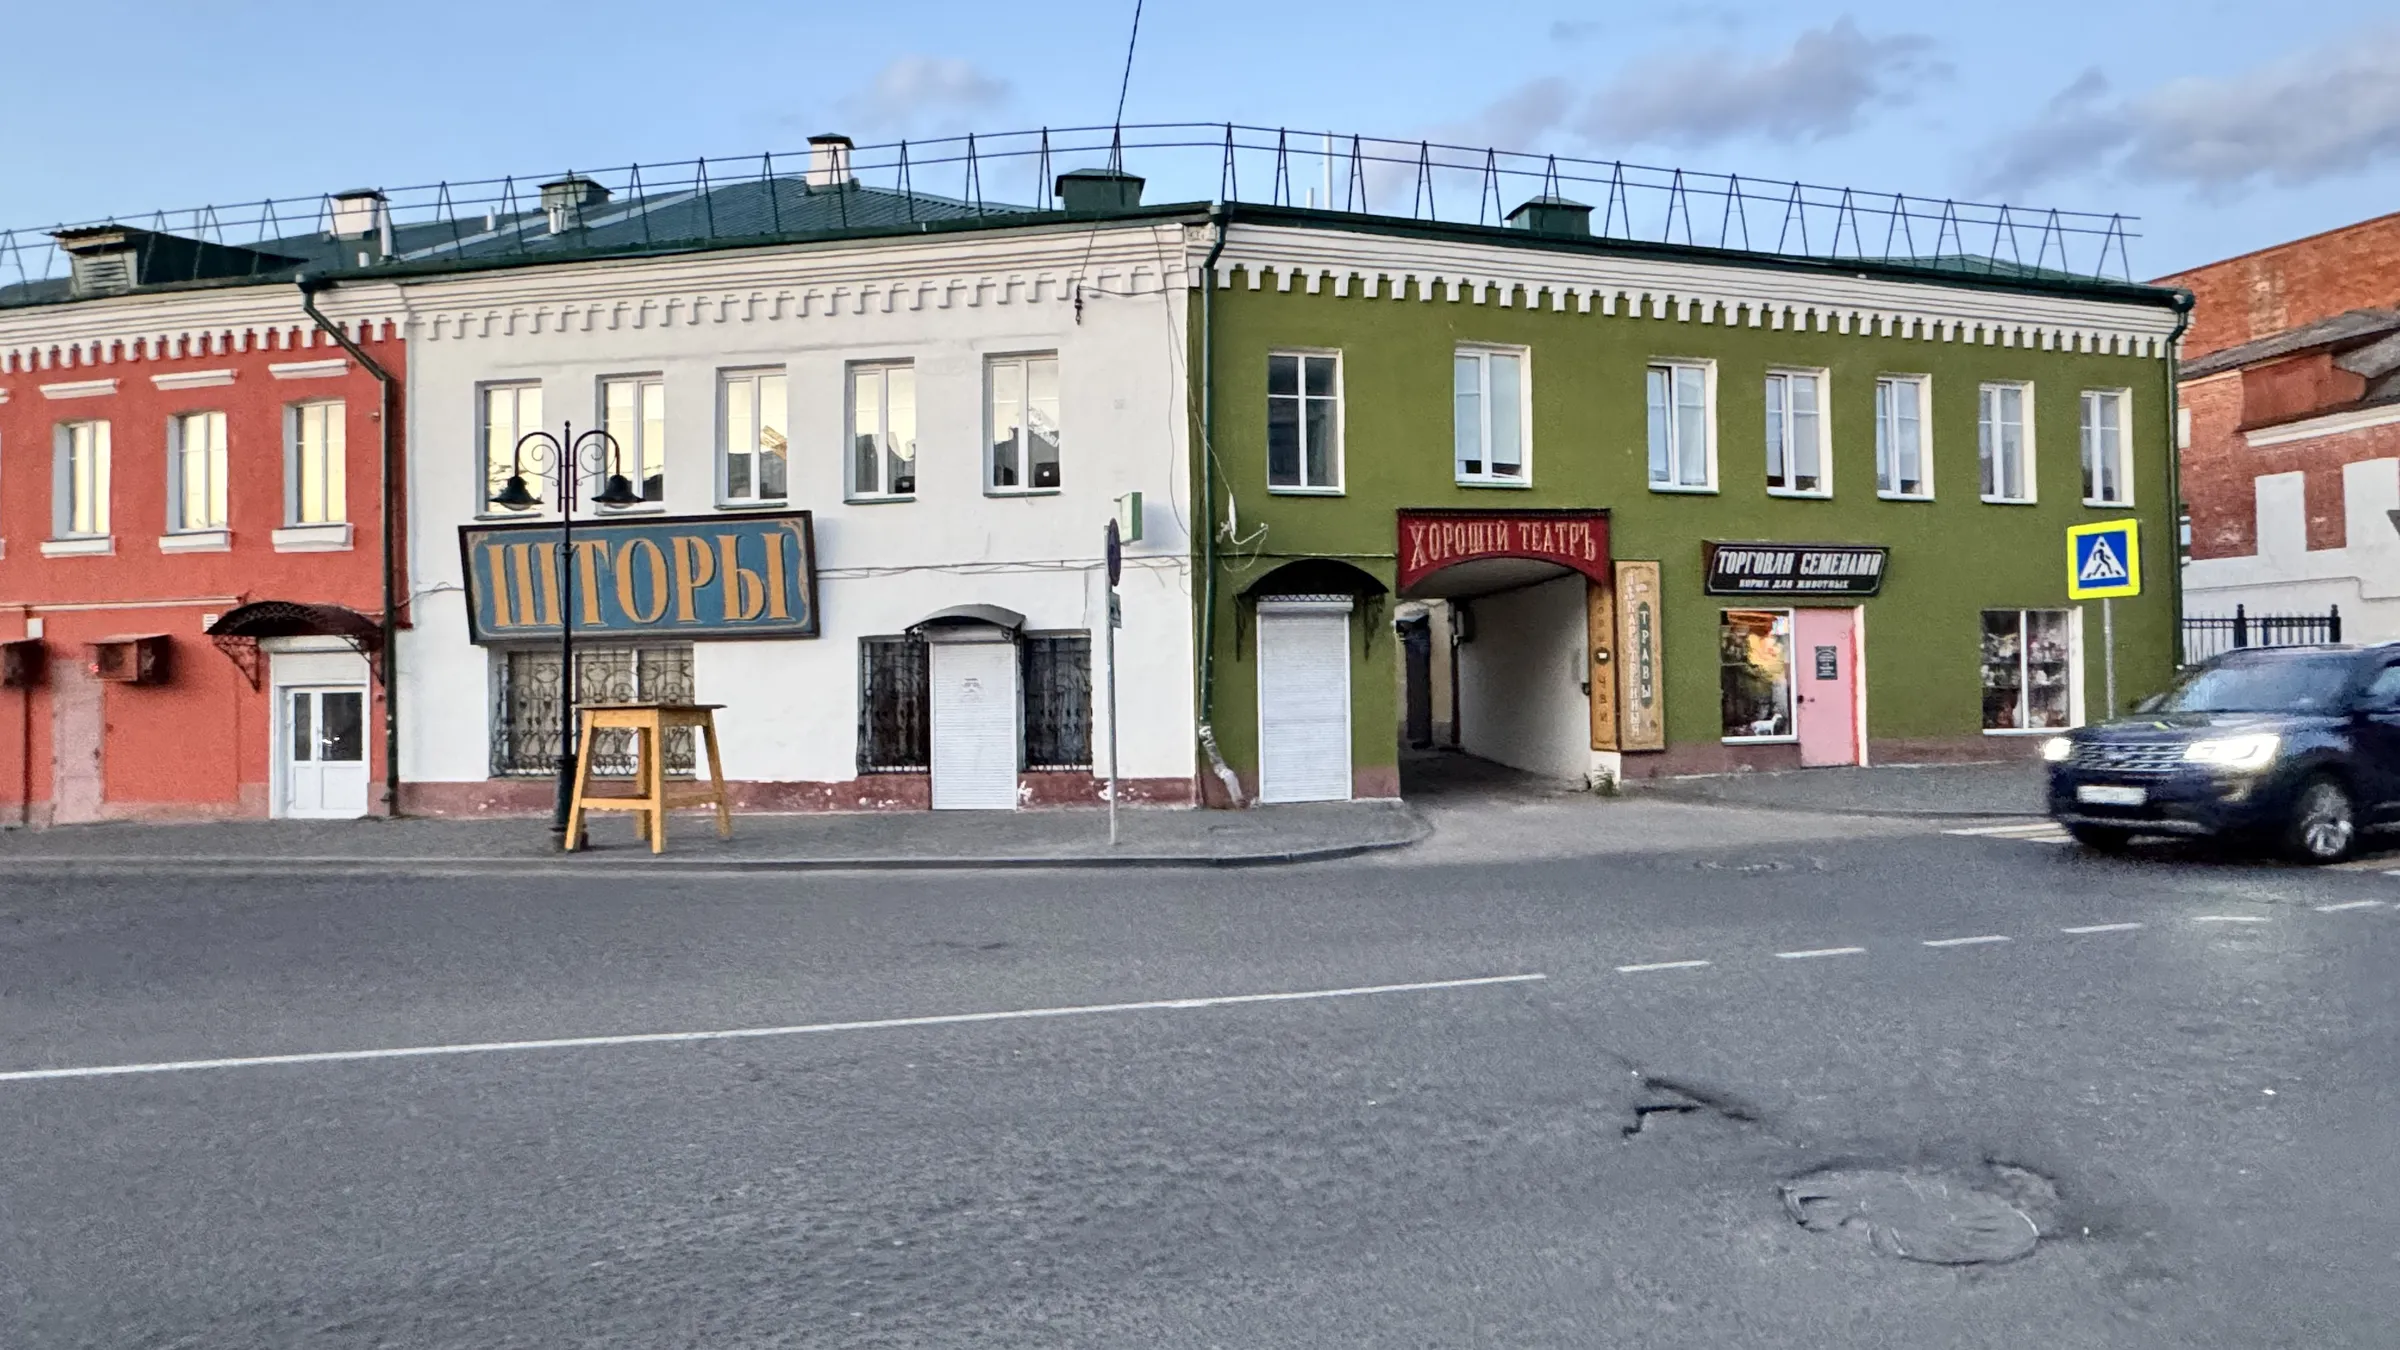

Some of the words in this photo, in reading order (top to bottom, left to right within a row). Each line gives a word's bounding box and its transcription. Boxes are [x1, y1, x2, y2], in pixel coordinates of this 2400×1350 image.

[1408, 520, 1510, 572] ХОРОШІЙ
[1518, 520, 1597, 561] ТЕАТРЪ
[1717, 551, 1795, 575] ТОРГОВЛЯ
[1799, 552, 1883, 576] СЕМЕНАМИ
[486, 532, 797, 629] ШТОРЫ
[1772, 579, 1794, 589] ДЛЯ
[1797, 579, 1850, 589] ЖИВОТНЫХ
[1639, 610, 1651, 698] ТРАВЫ
